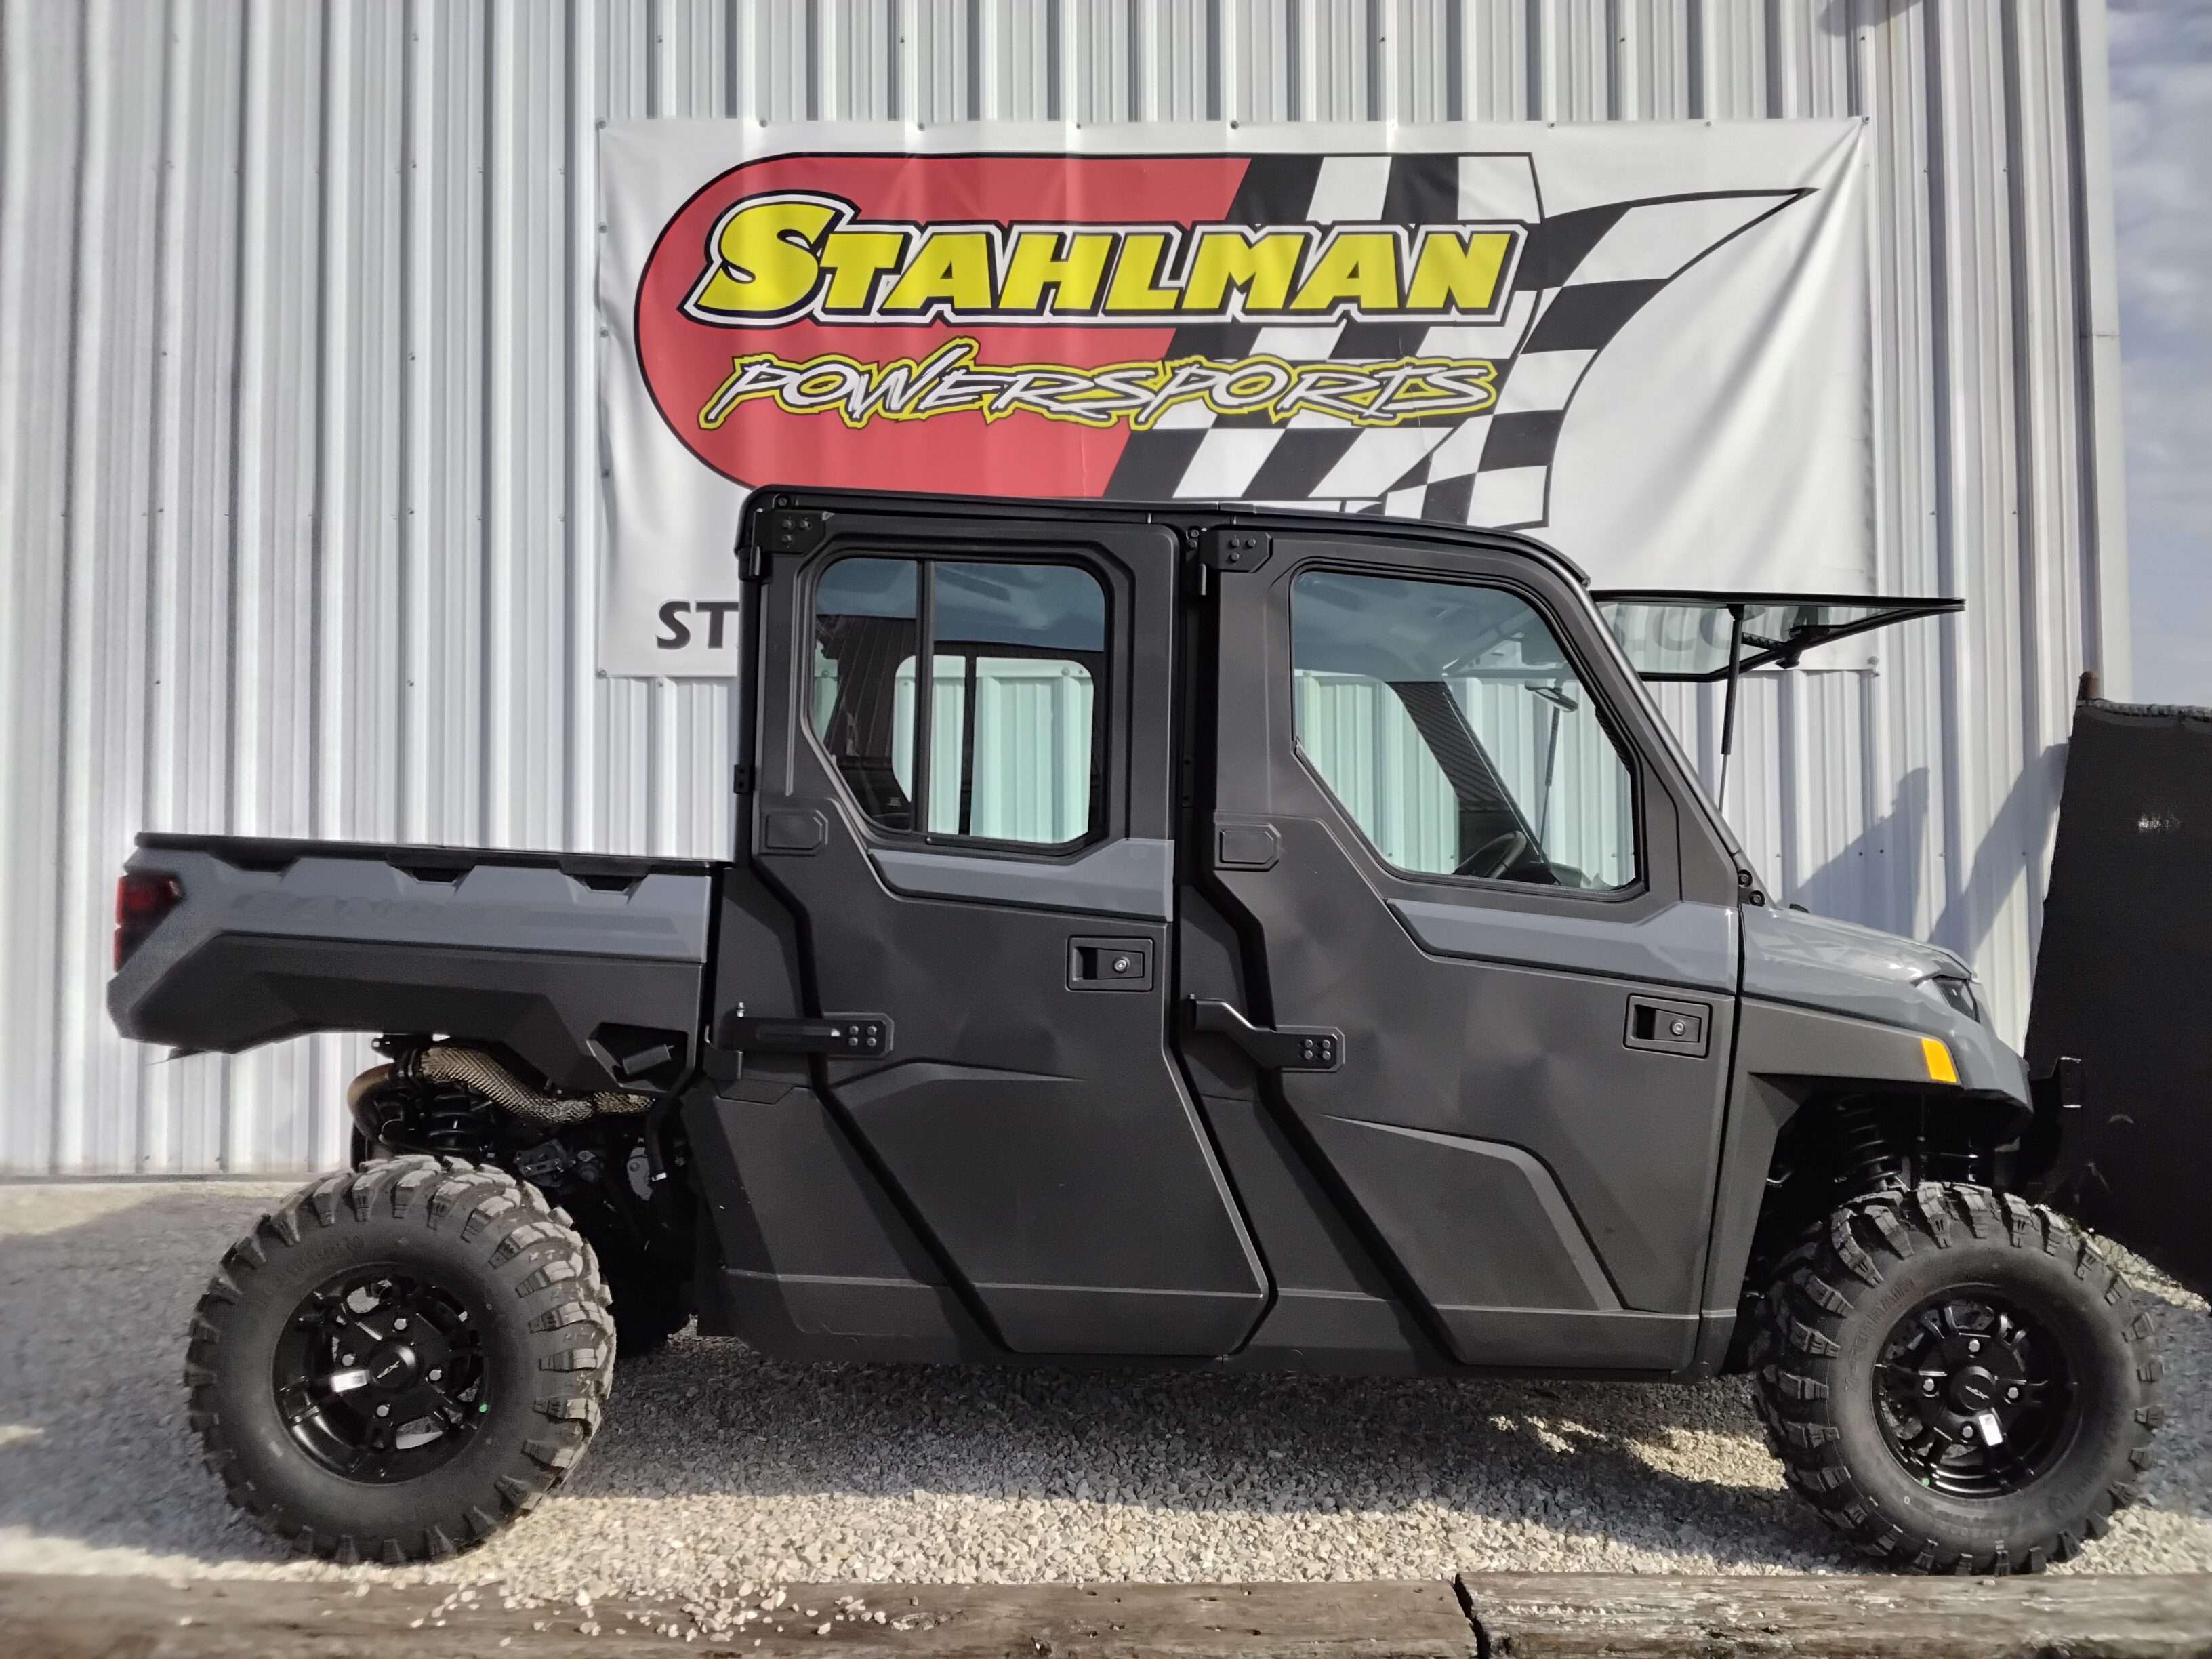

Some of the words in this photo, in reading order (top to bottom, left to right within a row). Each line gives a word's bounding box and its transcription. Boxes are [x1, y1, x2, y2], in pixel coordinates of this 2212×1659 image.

[679, 190, 1527, 329] STAHLMAN
[699, 336, 1498, 431] POWERSPORTS
[655, 599, 740, 649] ST
